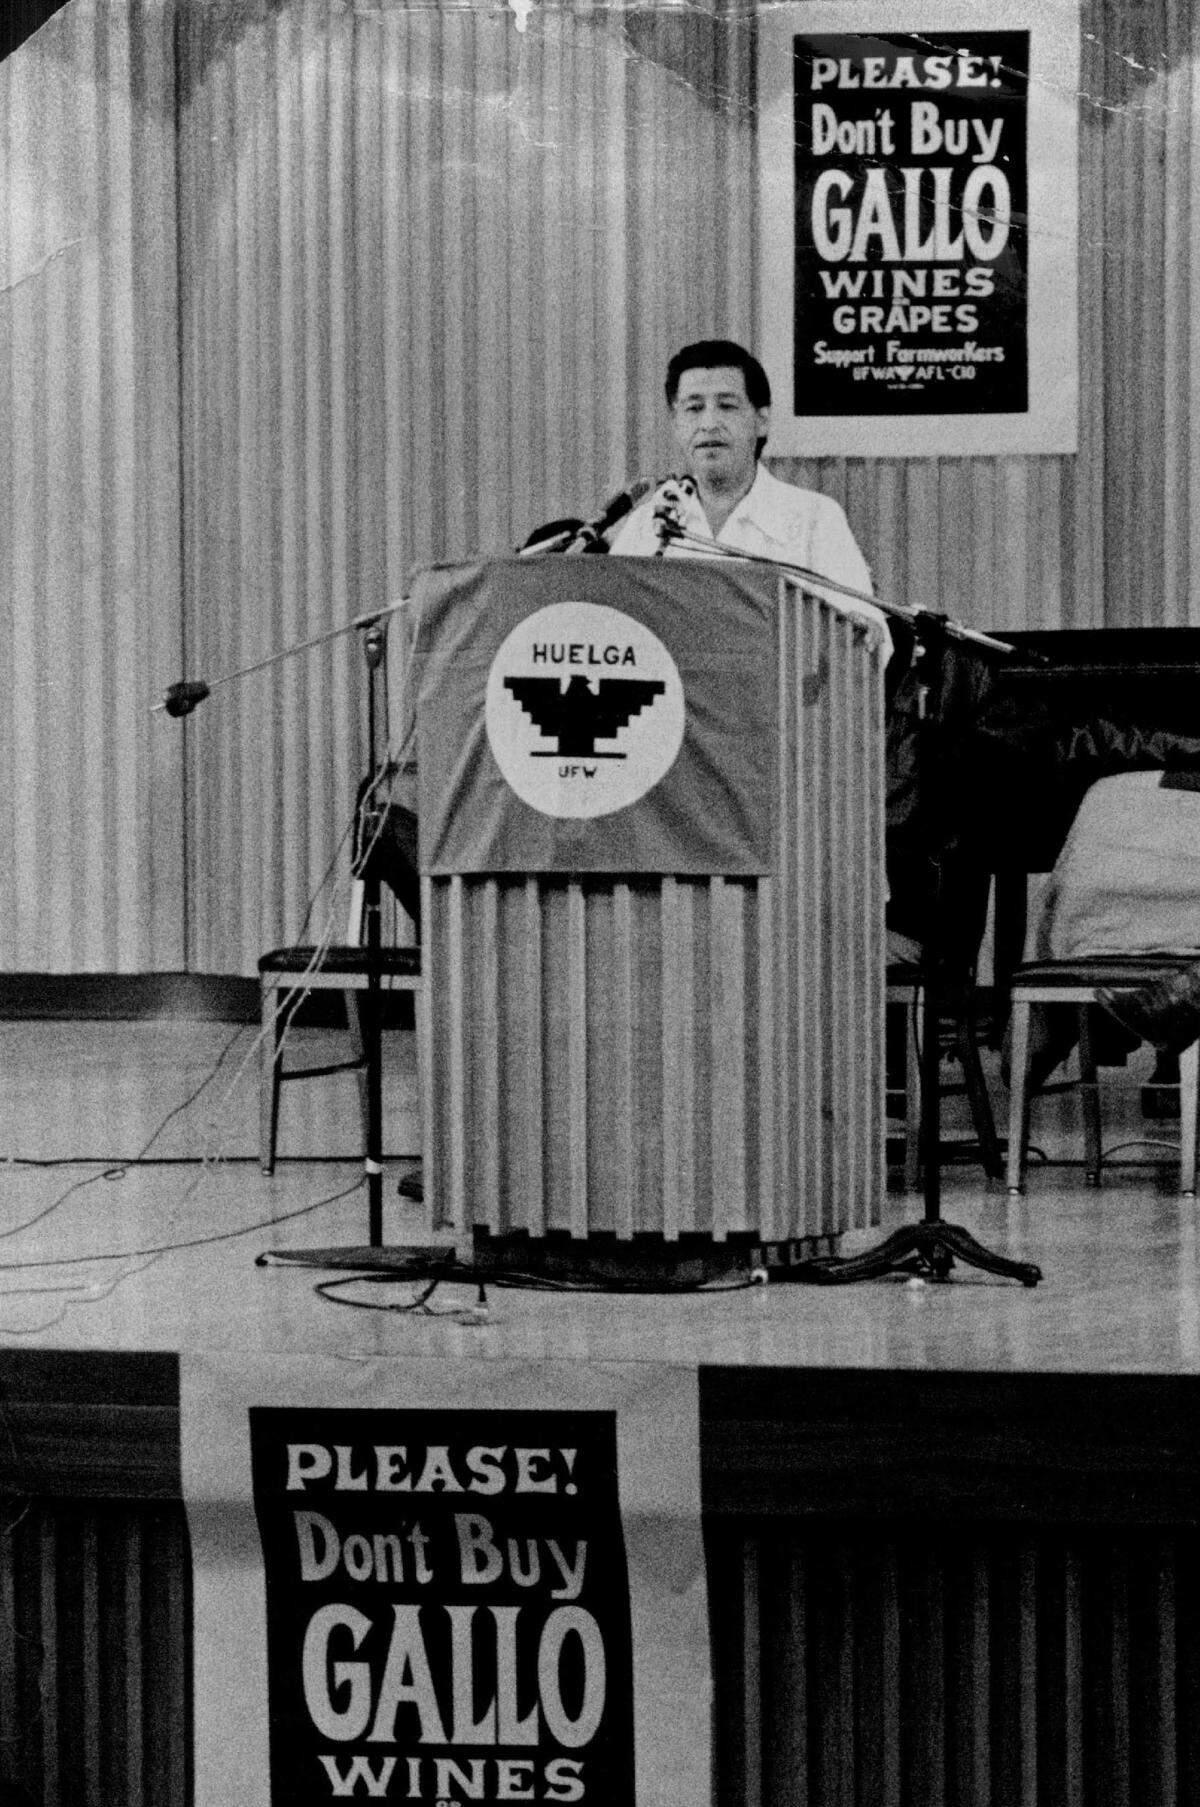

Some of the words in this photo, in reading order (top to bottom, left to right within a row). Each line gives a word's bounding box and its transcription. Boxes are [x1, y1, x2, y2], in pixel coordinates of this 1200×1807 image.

[811, 56, 1003, 89] PLEASE!
[811, 103, 895, 156] Don't
[911, 101, 1004, 163] Buy
[811, 164, 1011, 262] GALLO
[818, 267, 995, 299] WINES
[833, 304, 979, 334] GRAPES
[533, 643, 636, 666] HUELGA
[558, 765, 597, 778] UFW
[286, 1443, 578, 1496] PLEASE!
[293, 1510, 434, 1585] Don't
[454, 1512, 588, 1600] Buy
[302, 1603, 606, 1748] GALLO
[317, 1755, 585, 1801] WINES
